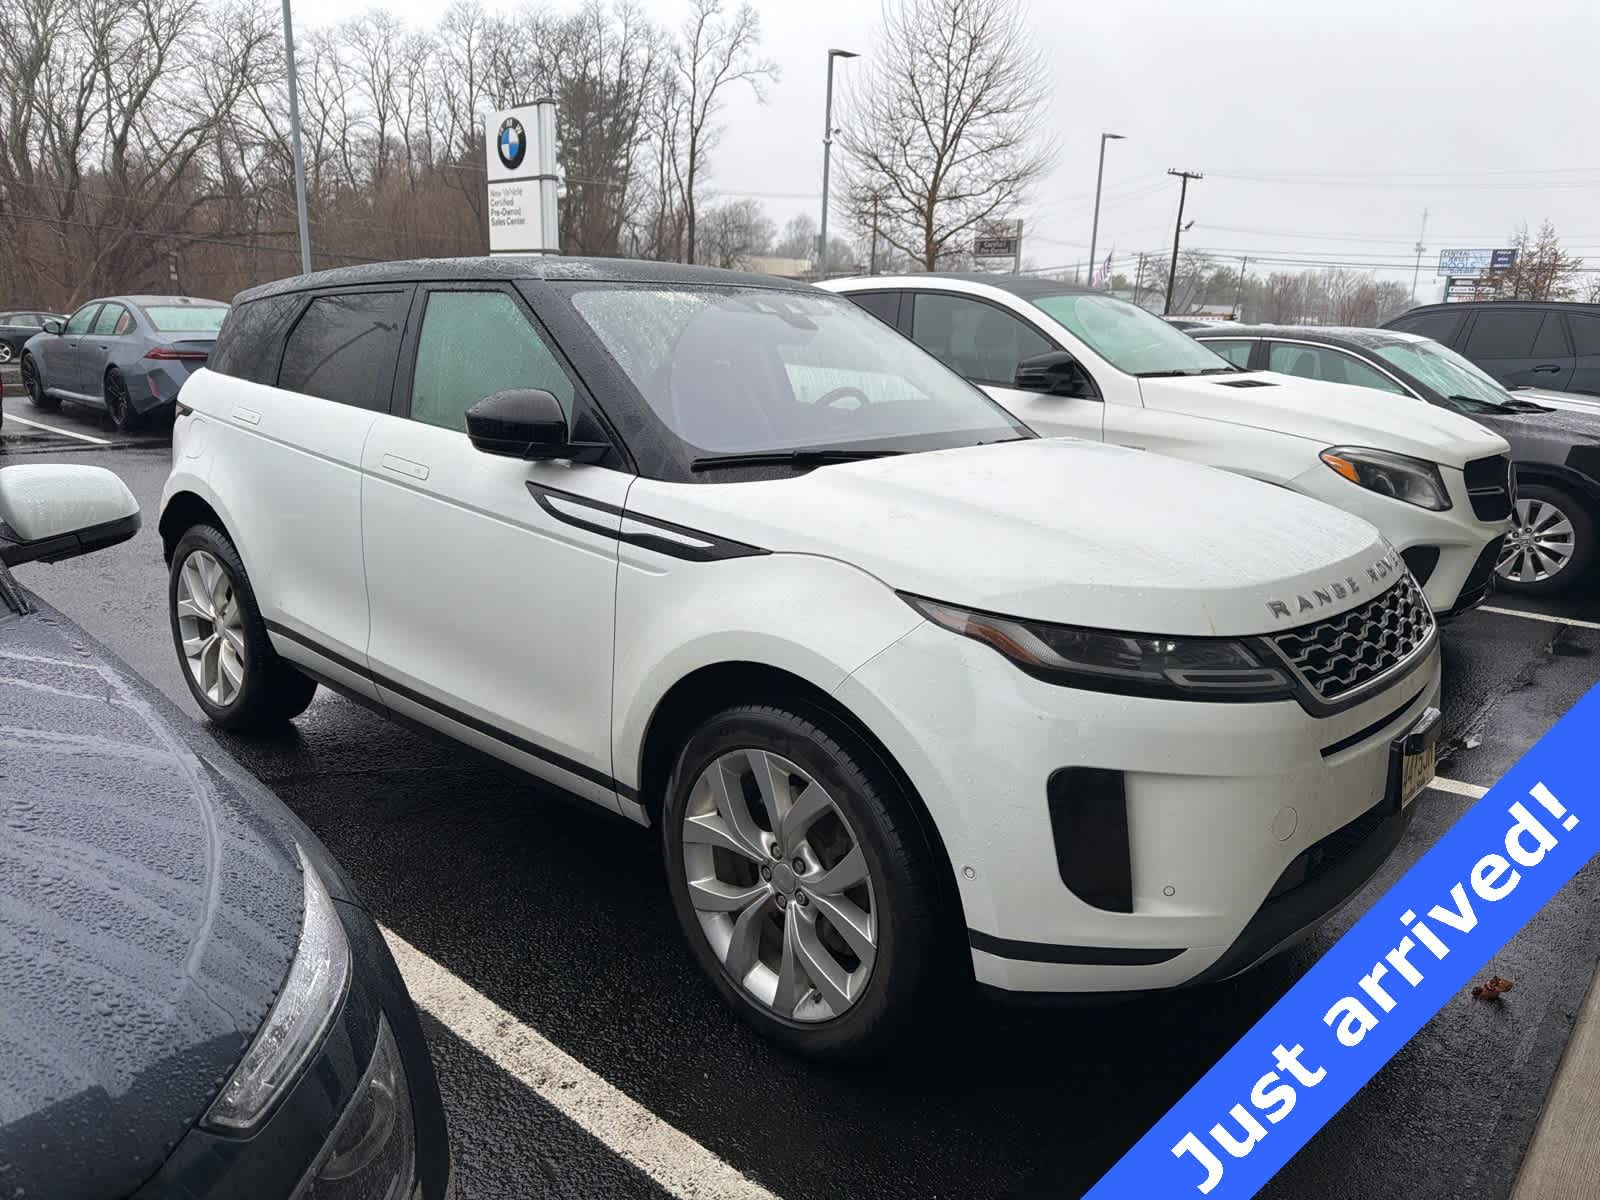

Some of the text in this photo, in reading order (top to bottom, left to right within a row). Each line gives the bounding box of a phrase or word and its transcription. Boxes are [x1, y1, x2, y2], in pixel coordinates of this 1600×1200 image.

[498, 118, 523, 136] BMW
[490, 197, 514, 207] Certified
[490, 207, 521, 217] Pre-Owned
[491, 216, 526, 226] Sales Center
[1266, 577, 1360, 619] RANGE
